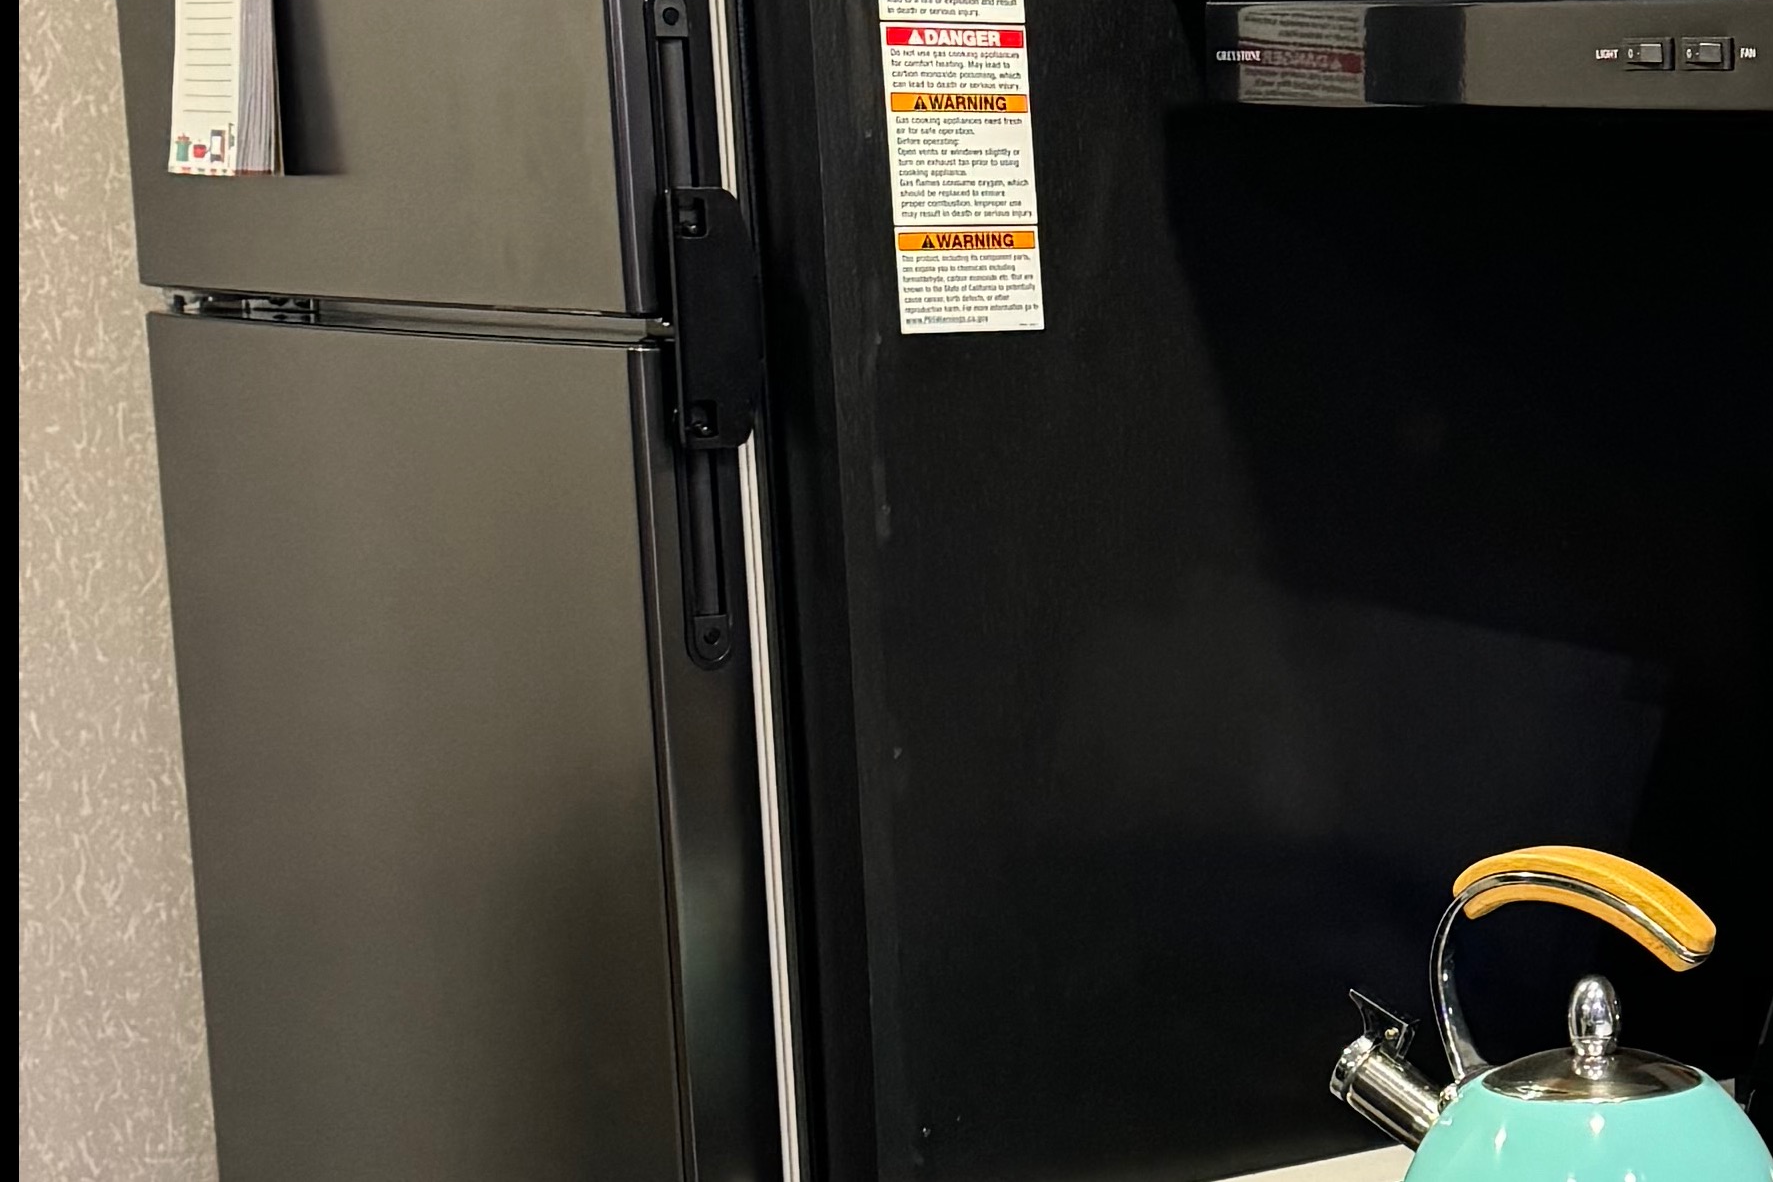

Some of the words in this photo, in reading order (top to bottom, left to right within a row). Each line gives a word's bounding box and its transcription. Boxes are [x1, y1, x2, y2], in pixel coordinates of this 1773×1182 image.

[924, 30, 1001, 46] DANGER
[1596, 49, 1618, 60] LIGHT
[1740, 48, 1756, 58] FAN
[929, 95, 1007, 111] WARNING
[937, 234, 1014, 248] WARNING
